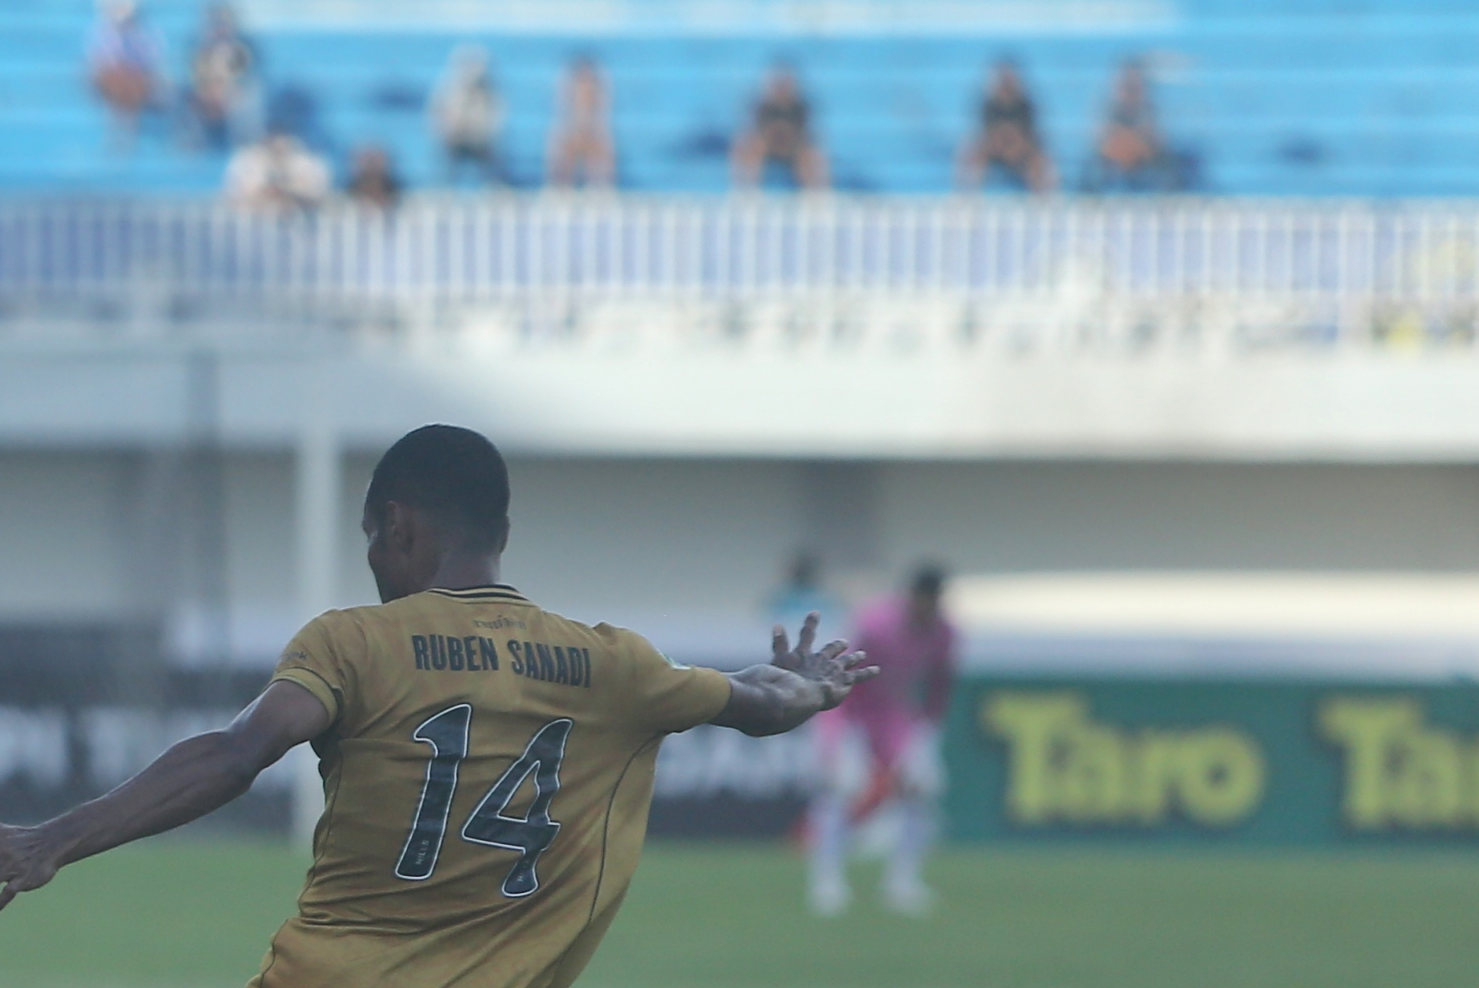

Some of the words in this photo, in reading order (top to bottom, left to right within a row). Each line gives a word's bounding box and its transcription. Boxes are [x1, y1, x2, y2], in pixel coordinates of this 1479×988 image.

[411, 636, 499, 671] RUBEN
[507, 639, 592, 688] SANADI
[394, 703, 573, 897] 14
[983, 692, 1260, 824] Taro
